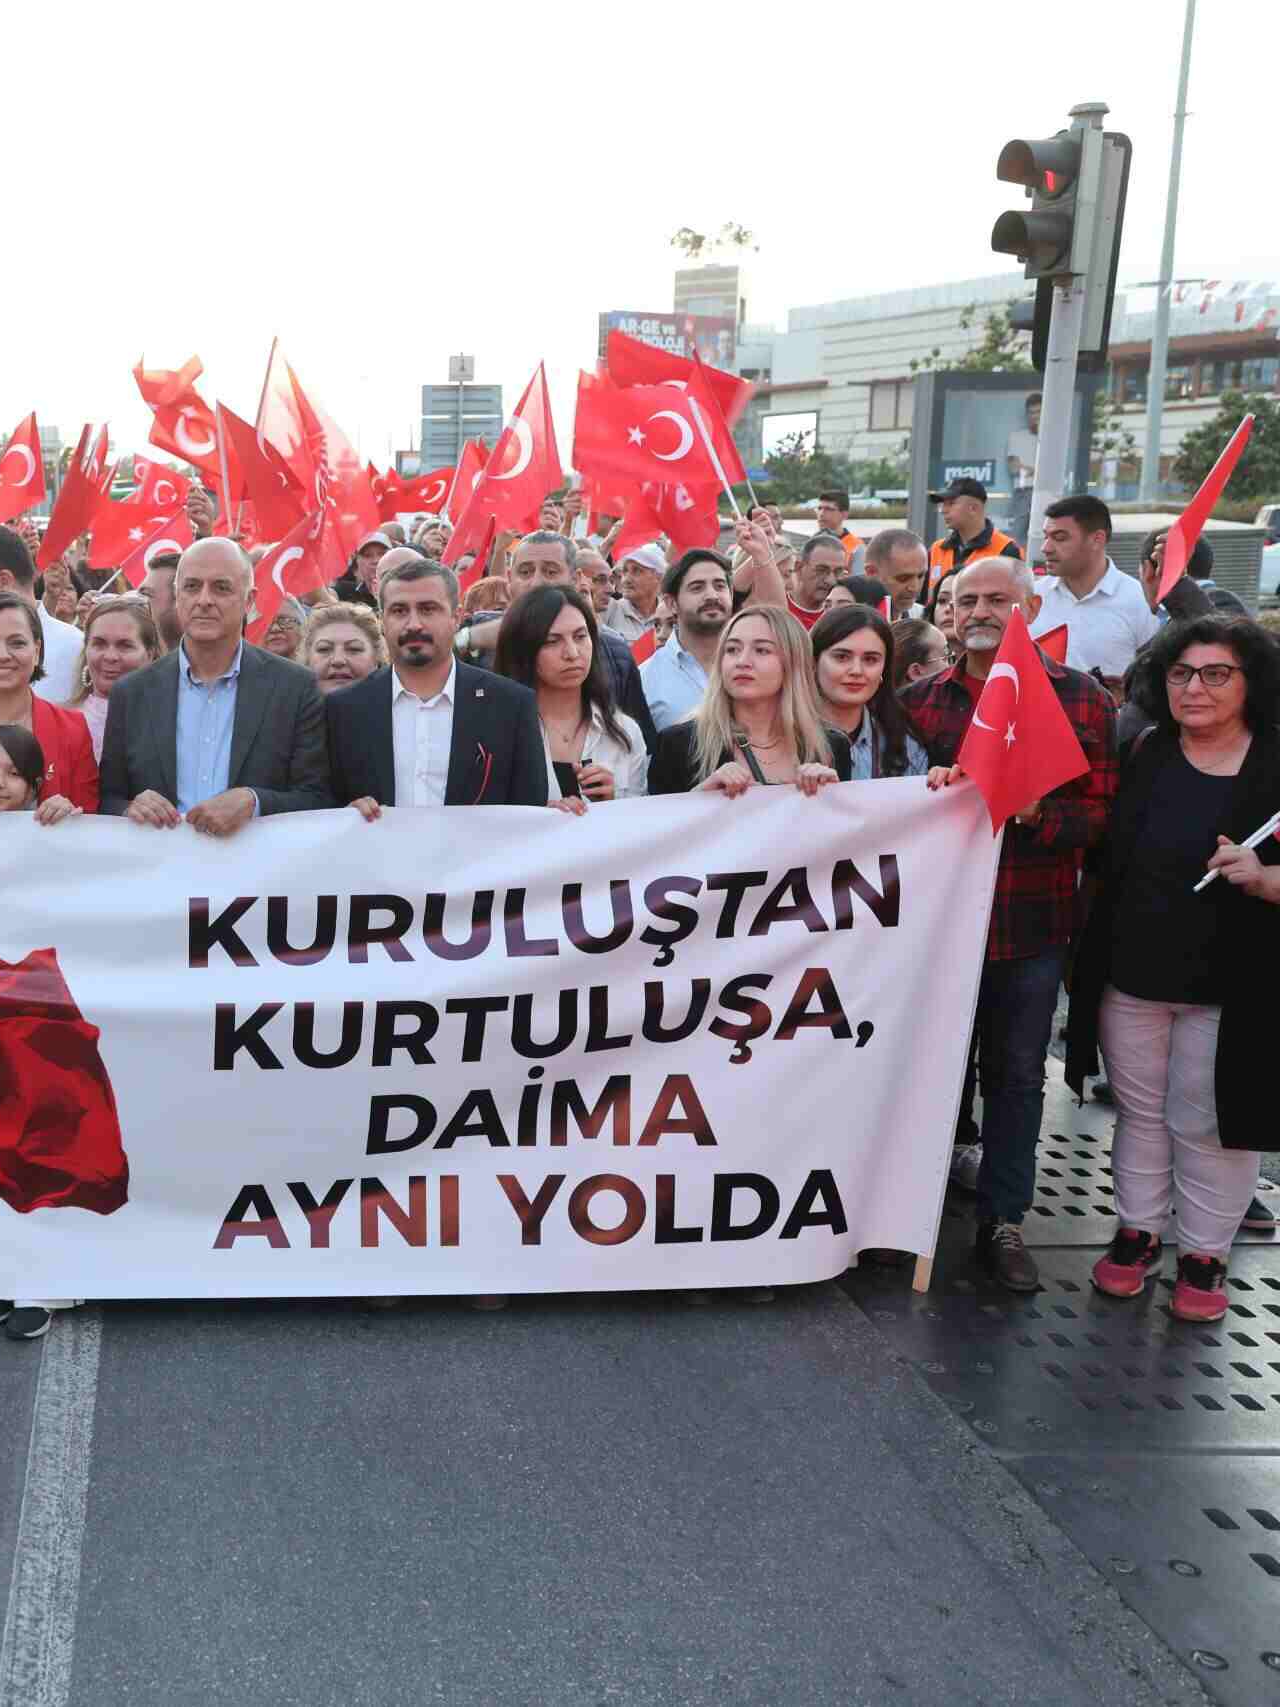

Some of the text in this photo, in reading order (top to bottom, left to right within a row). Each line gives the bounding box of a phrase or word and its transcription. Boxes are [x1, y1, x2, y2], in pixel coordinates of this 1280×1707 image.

[944, 461, 992, 482] mavi
[188, 853, 901, 969] KURULUŞTAN
[213, 967, 875, 1071] KURTULUŞA,
[365, 1065, 719, 1156] DAİMA
[213, 1169, 849, 1249] AYNI YOLDA
